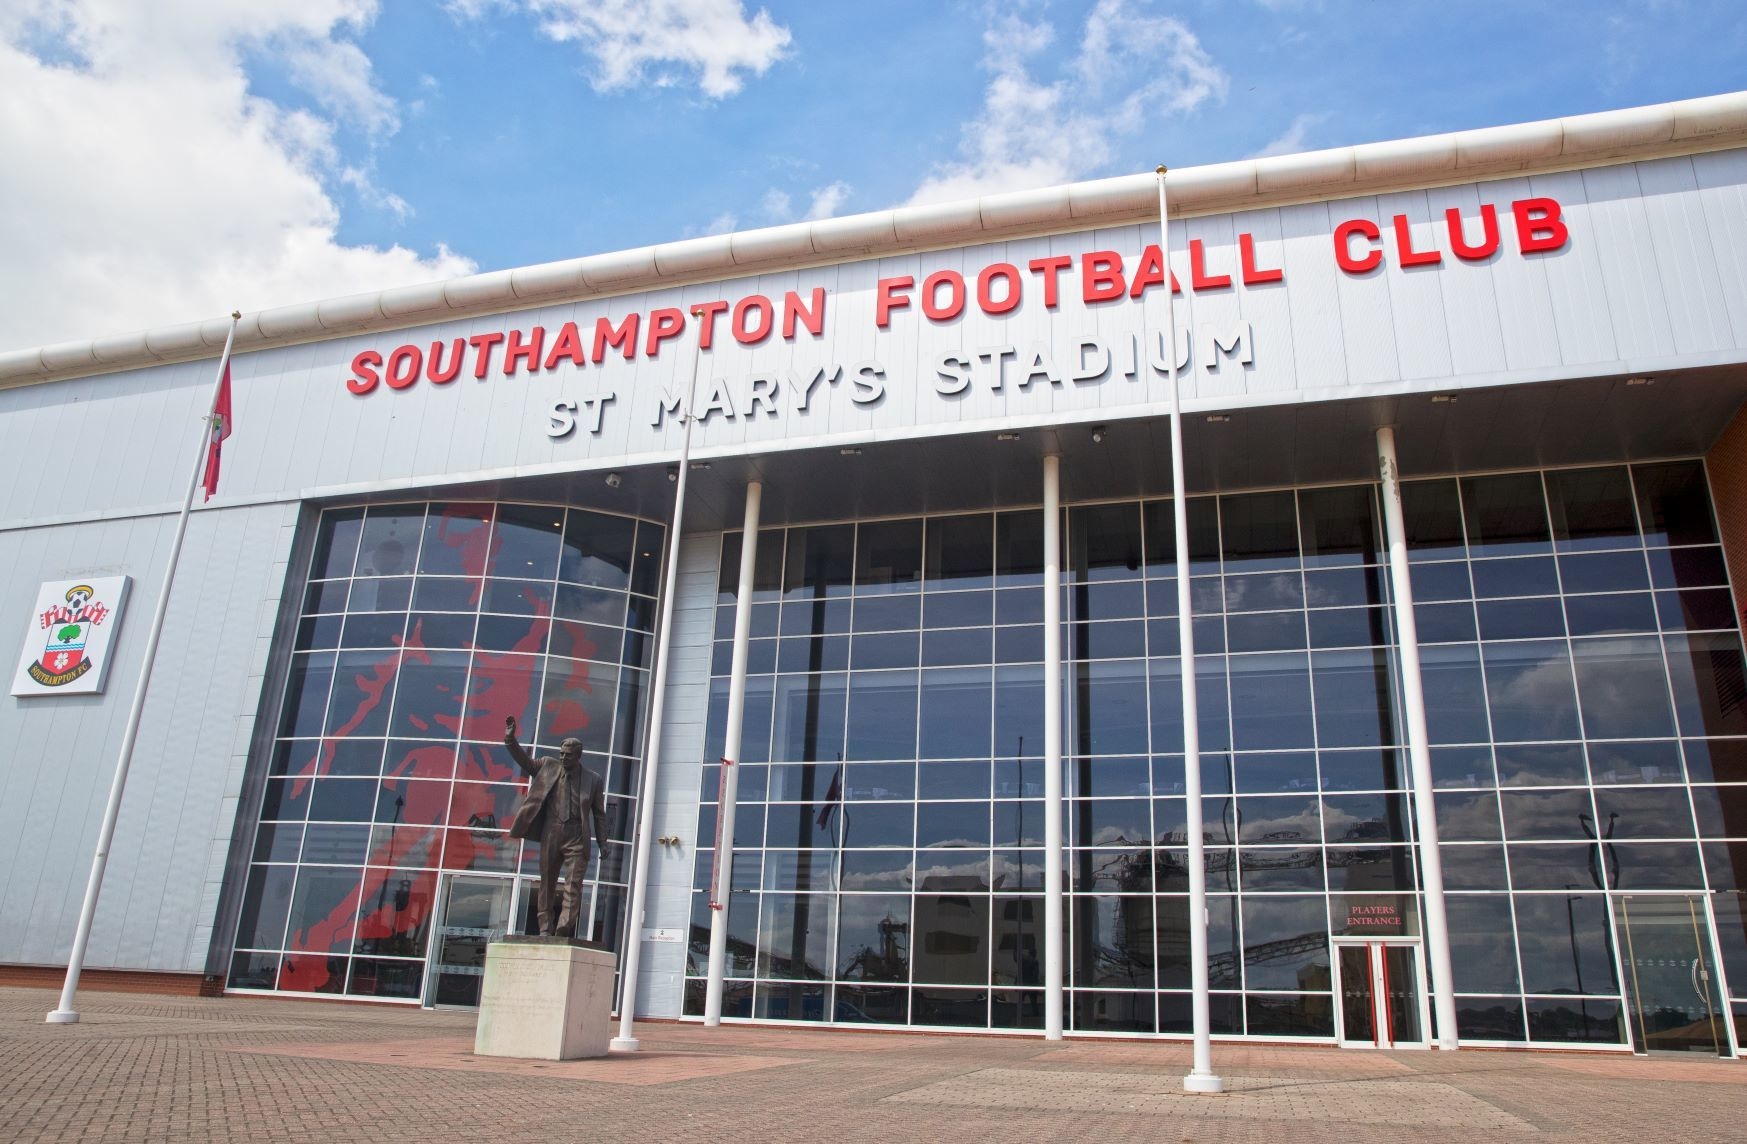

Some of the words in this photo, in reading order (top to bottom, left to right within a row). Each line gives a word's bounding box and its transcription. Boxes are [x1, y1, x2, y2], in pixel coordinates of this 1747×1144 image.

[345, 287, 826, 397] SOUTHAMPTON
[875, 232, 1285, 328] FOOTBALL
[1332, 196, 1570, 276] CLUB
[546, 392, 617, 439] ST
[650, 358, 885, 428] MARY'S
[933, 319, 1255, 395] STADIUM
[31, 665, 76, 685] SOUTHAMPTON
[78, 662, 88, 675] FC
[1347, 917, 1401, 925] ENTRANCE
[1351, 906, 1395, 914] PLAYERS
